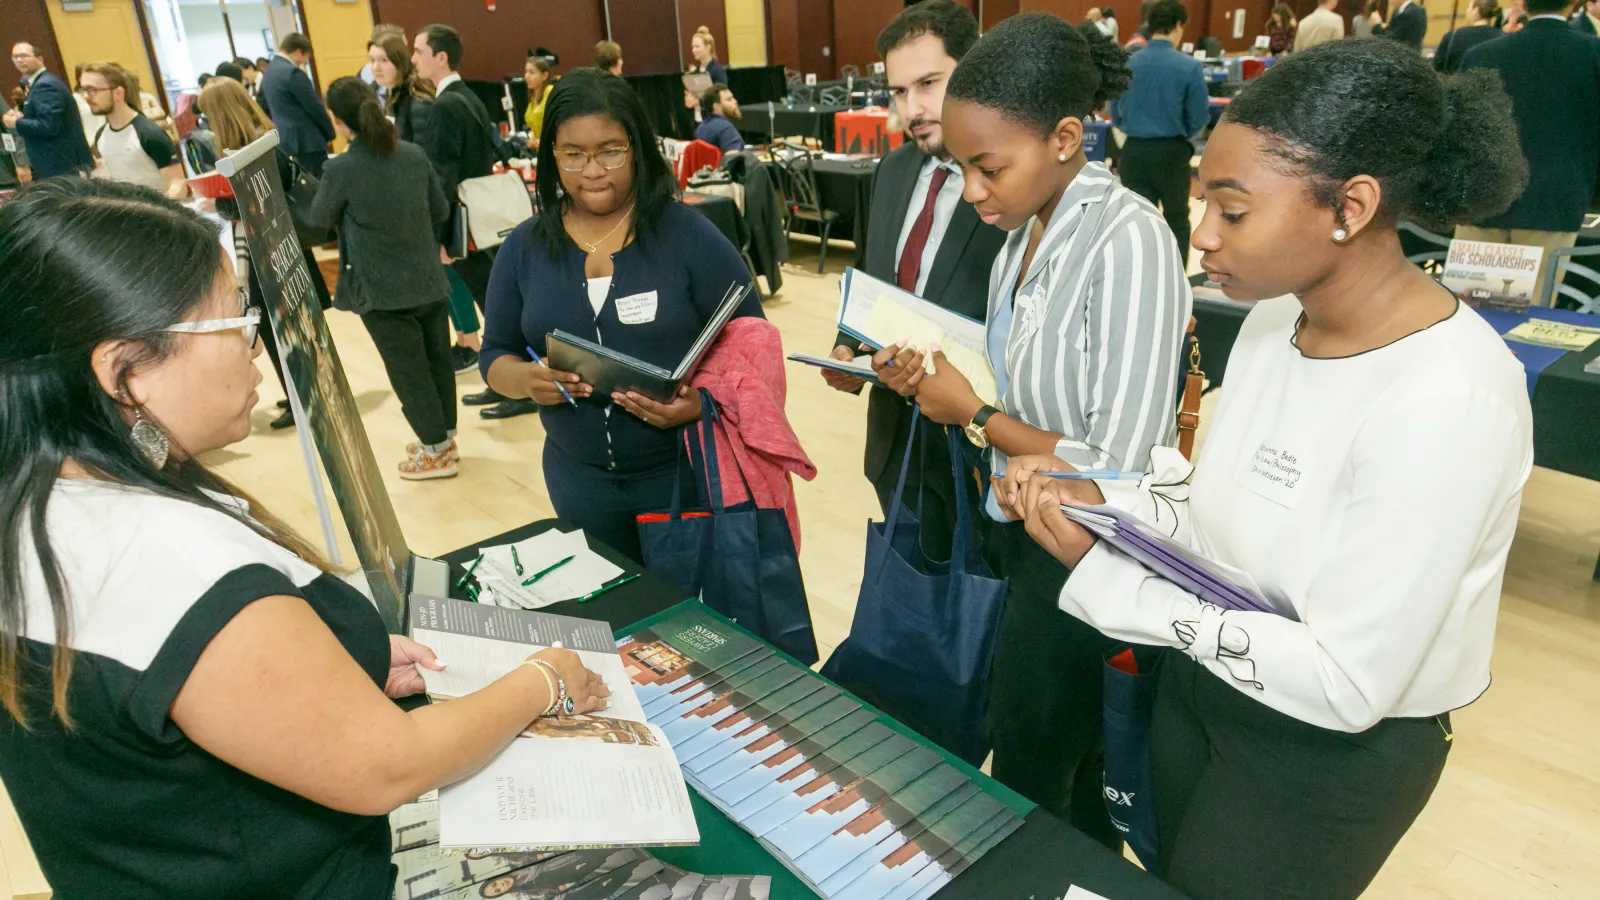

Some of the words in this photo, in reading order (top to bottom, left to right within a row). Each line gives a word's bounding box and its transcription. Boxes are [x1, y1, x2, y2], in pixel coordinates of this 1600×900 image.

[250, 168, 272, 214] JOIN
[270, 231, 300, 283] SPARTAN
[1452, 241, 1480, 253] SMALL
[1484, 243, 1525, 258] CLASSES
[1450, 250, 1465, 264] BIG
[1466, 252, 1537, 271] SCHOLARSHIPS
[281, 261, 310, 316] NATION
[1472, 289, 1491, 299] LMU
[684, 629, 718, 648] LEADERS
[496, 776, 505, 798] YOUR
[528, 787, 536, 803] Law
[498, 800, 507, 820] FIND
[518, 788, 528, 820] Explore
